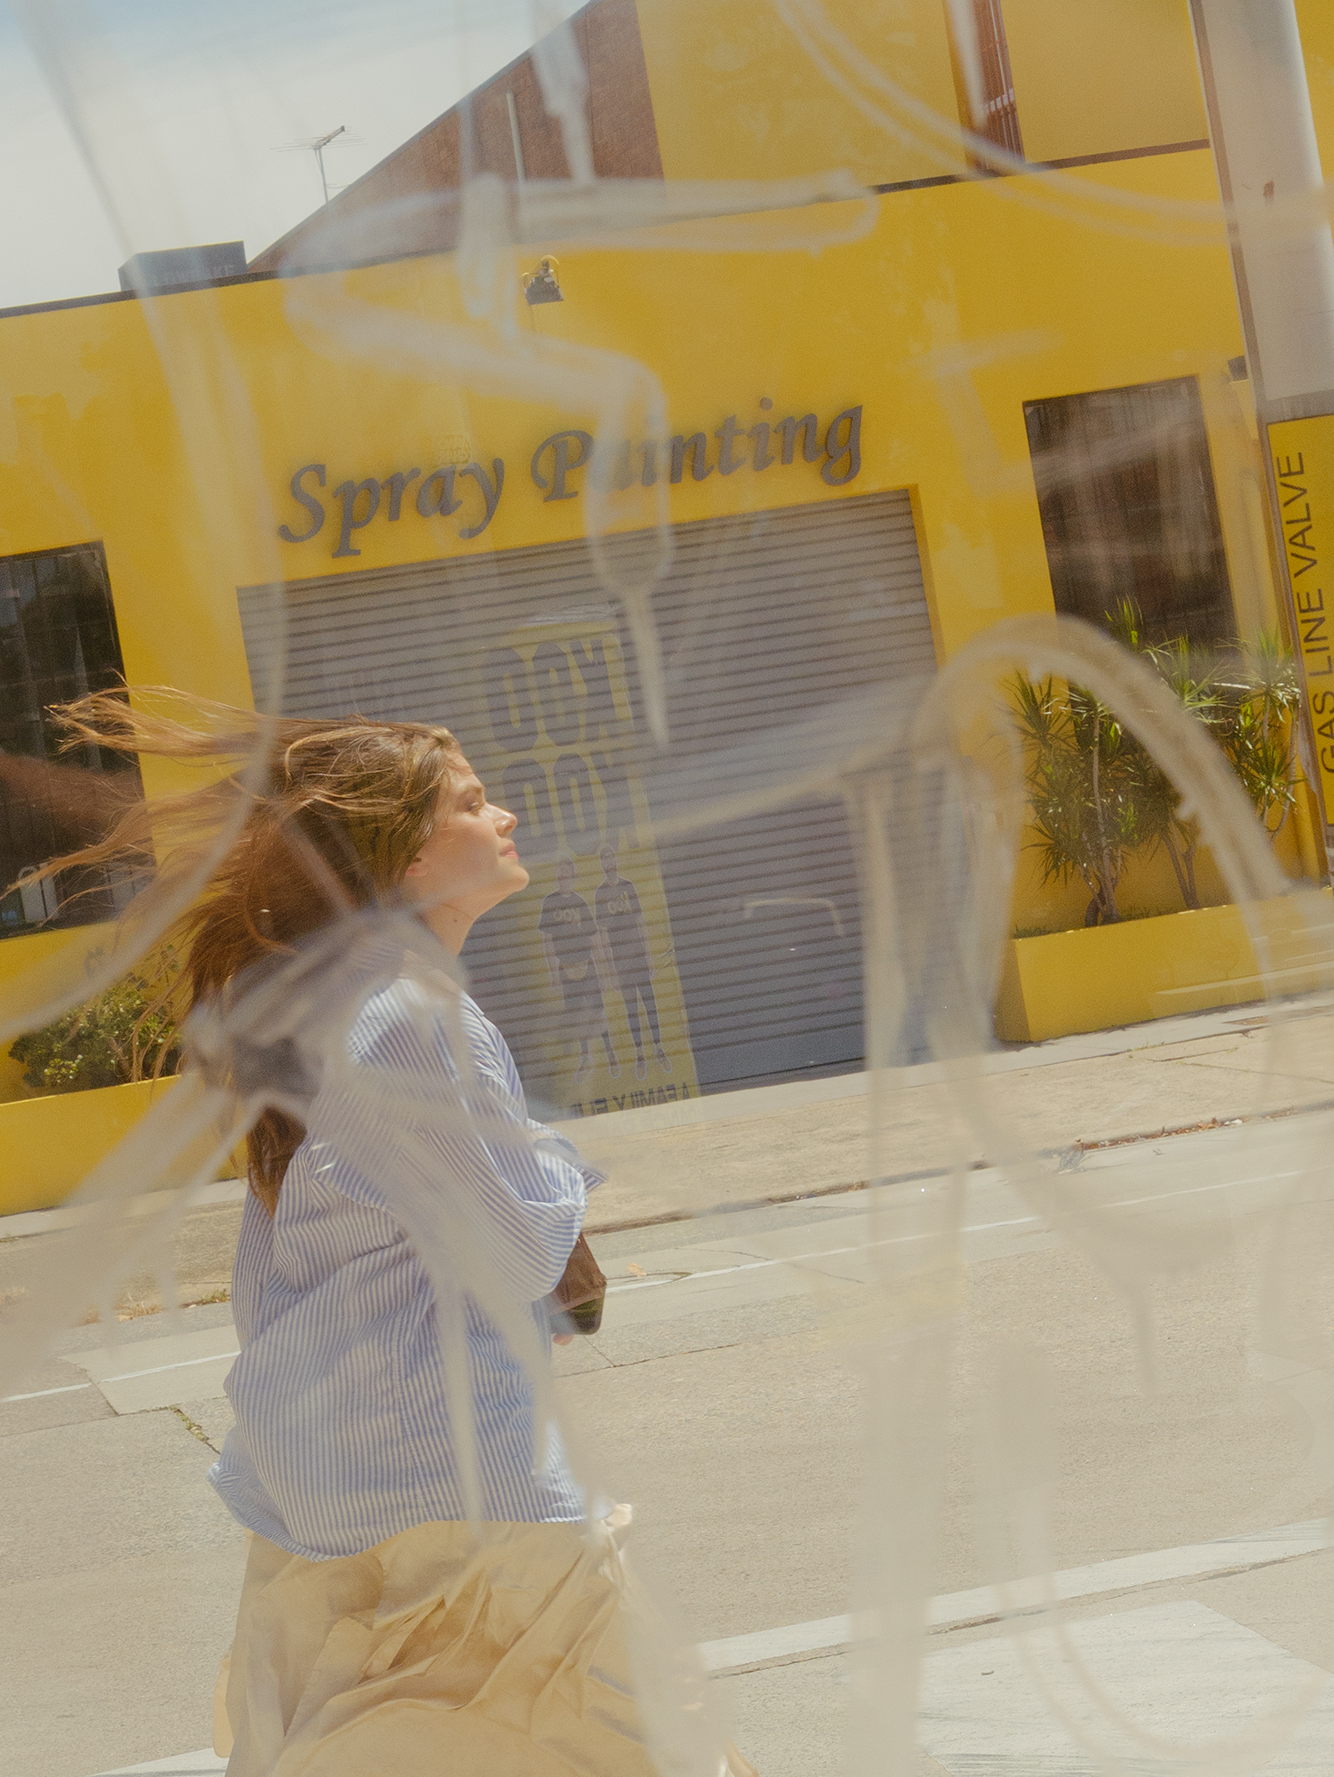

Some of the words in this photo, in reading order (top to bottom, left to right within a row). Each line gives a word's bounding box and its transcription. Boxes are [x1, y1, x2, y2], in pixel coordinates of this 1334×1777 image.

[277, 457, 504, 559] Spray
[1276, 452, 1319, 578] VALVE
[1298, 587, 1334, 677] LINE
